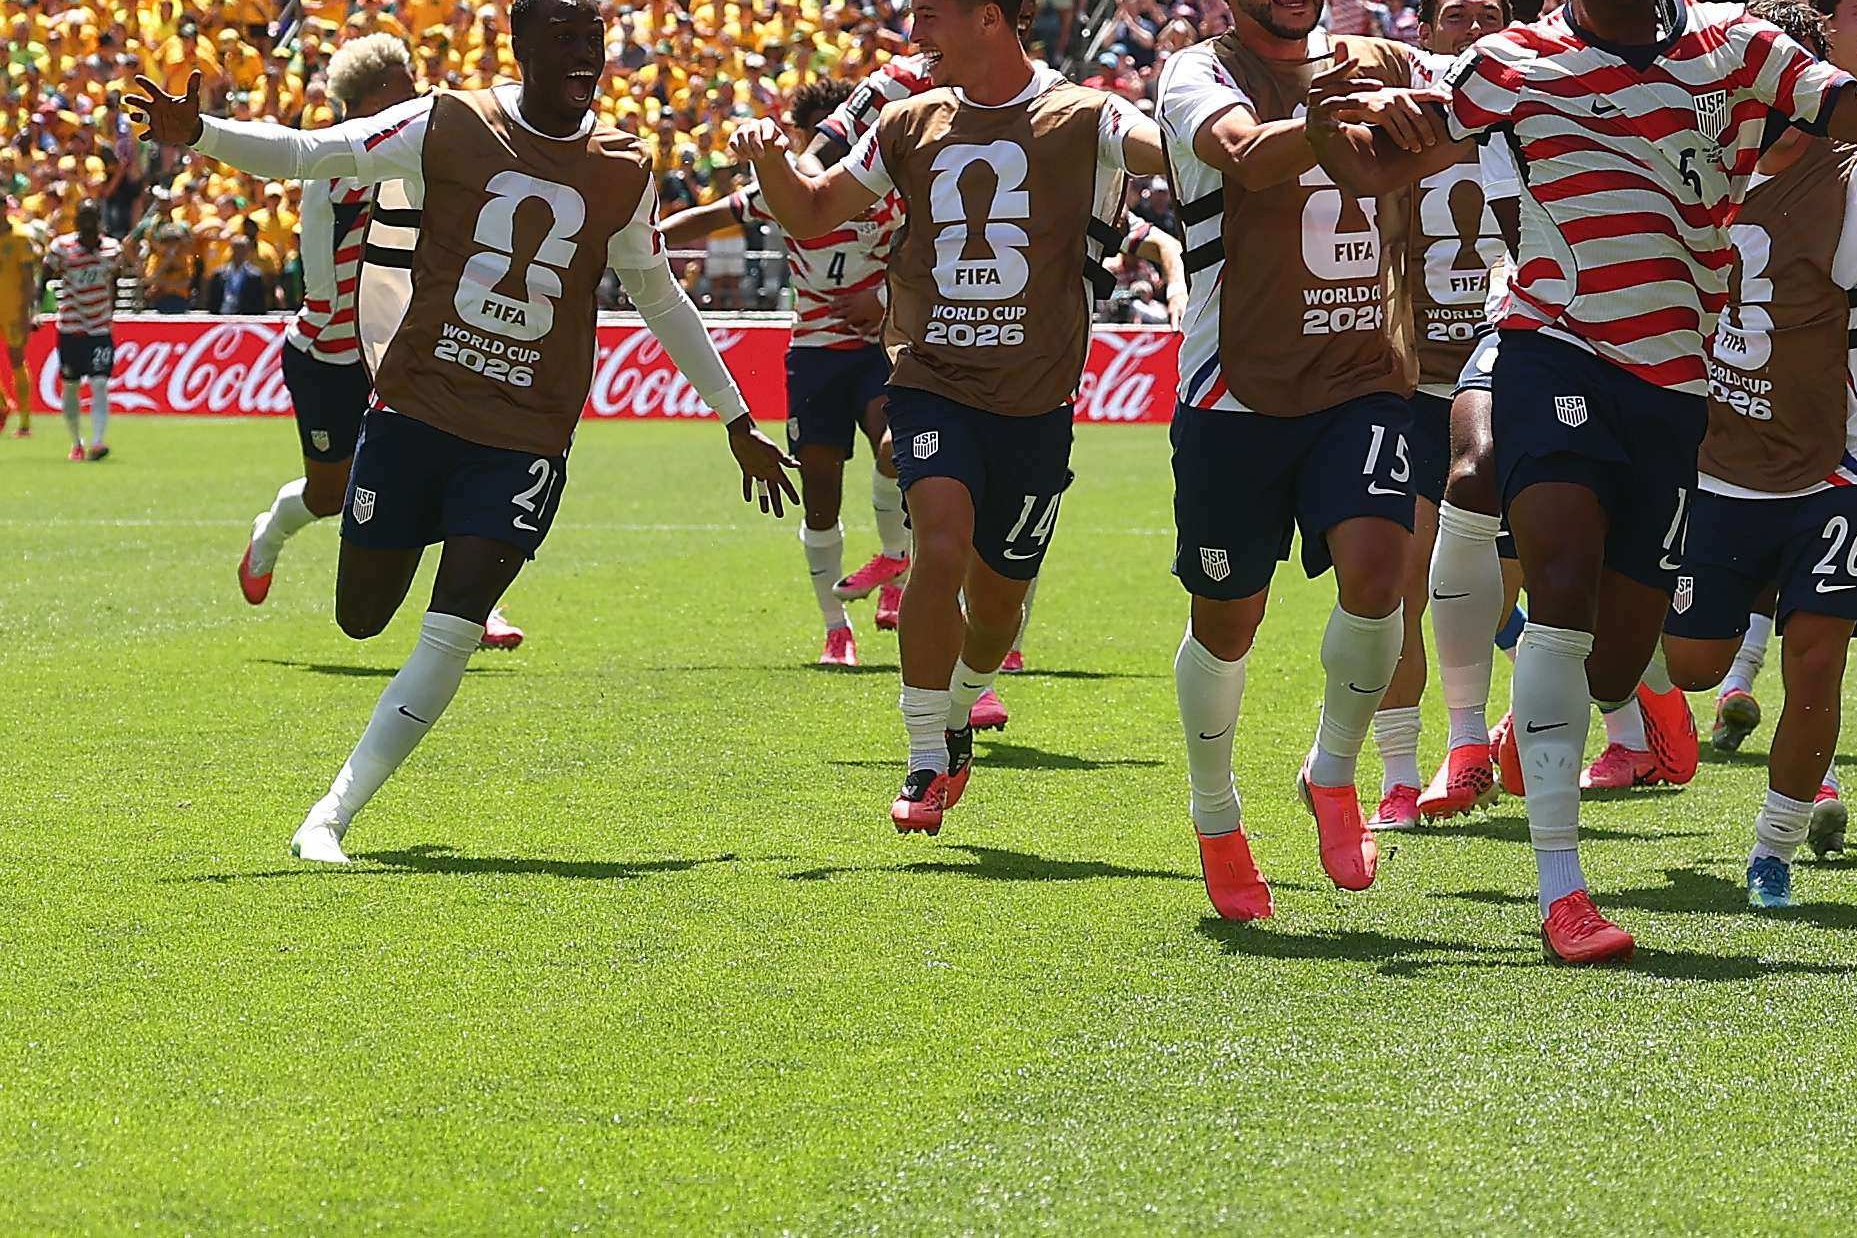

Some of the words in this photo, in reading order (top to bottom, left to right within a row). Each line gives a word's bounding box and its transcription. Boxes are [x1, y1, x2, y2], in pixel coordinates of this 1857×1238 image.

[1697, 91, 1724, 113] USA
[1334, 241, 1375, 262] FIFA
[827, 252, 846, 285] 4
[955, 268, 1001, 285] FIFA
[1304, 286, 1364, 305] WORLD
[481, 299, 527, 327] FIFA
[932, 304, 990, 321] WORLD
[992, 306, 1027, 321] CUP
[1425, 308, 1485, 320] WORLD
[442, 322, 505, 355] WORLD
[507, 345, 541, 364] CUP
[925, 321, 1025, 347] 2026
[1721, 330, 1747, 355] FIFA
[434, 338, 535, 387] 2026
[1710, 365, 1741, 386] ORLD
[1742, 376, 1773, 395] CUP
[1558, 397, 1584, 409] USA
[1707, 379, 1773, 420] 026
[1363, 424, 1410, 483] 15
[356, 488, 375, 504] USA
[1004, 492, 1061, 546] 14
[1202, 548, 1227, 562] USA
